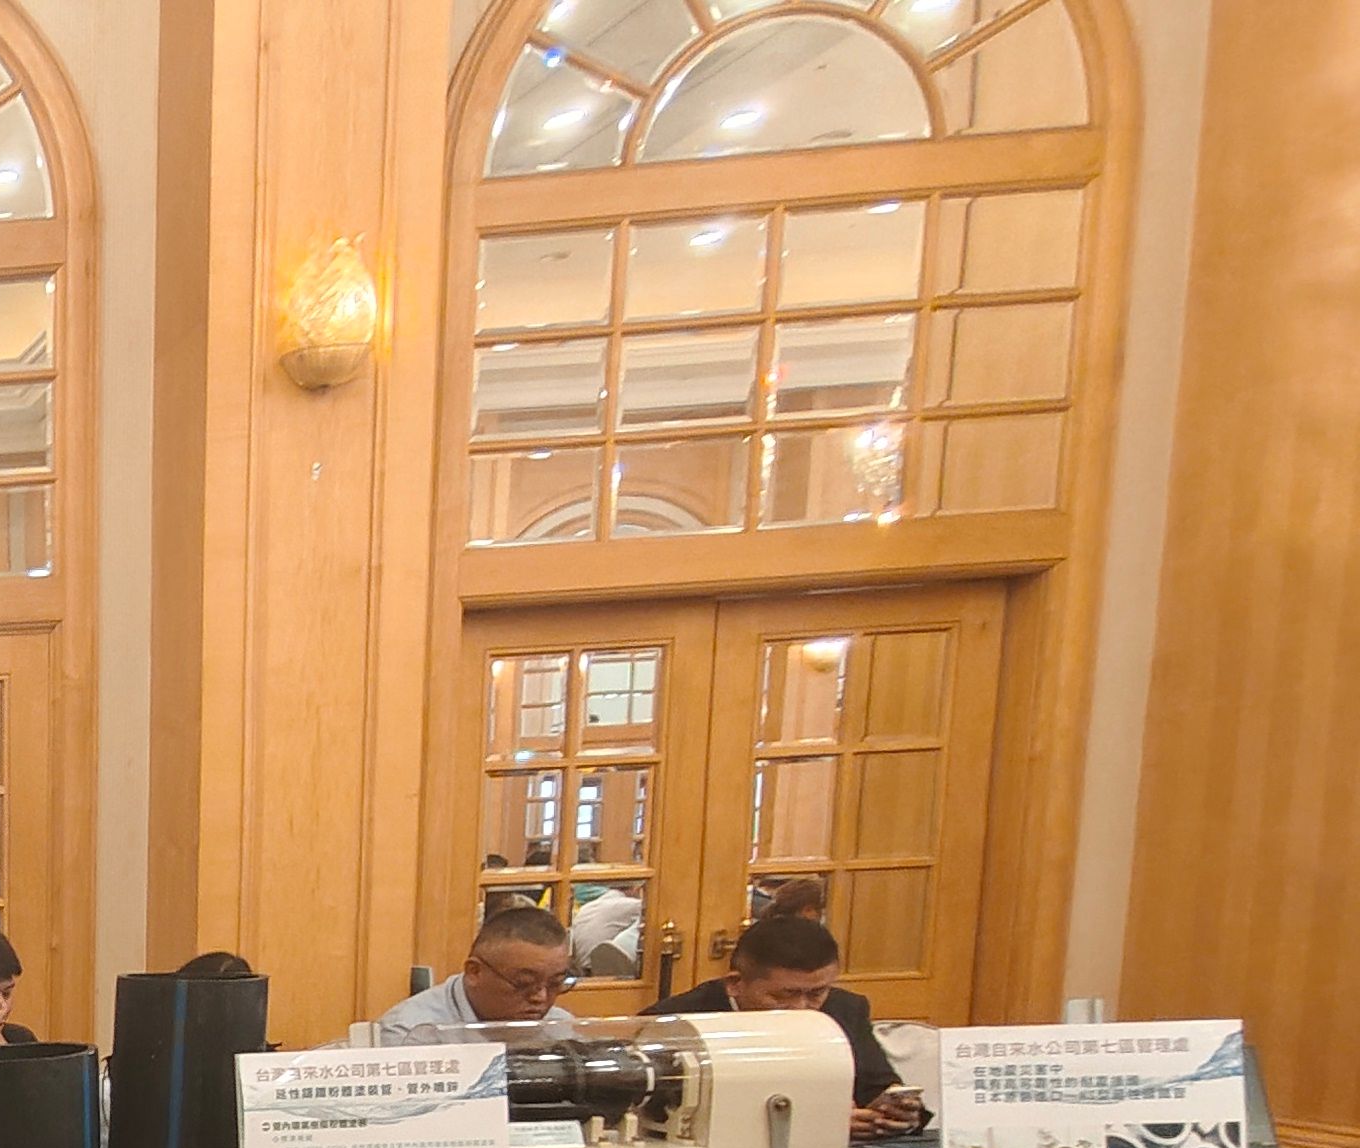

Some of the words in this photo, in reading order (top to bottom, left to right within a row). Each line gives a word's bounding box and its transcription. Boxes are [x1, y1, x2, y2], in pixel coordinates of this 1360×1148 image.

[955, 1037, 1190, 1059] 台灣自來水公司第七區管理處
